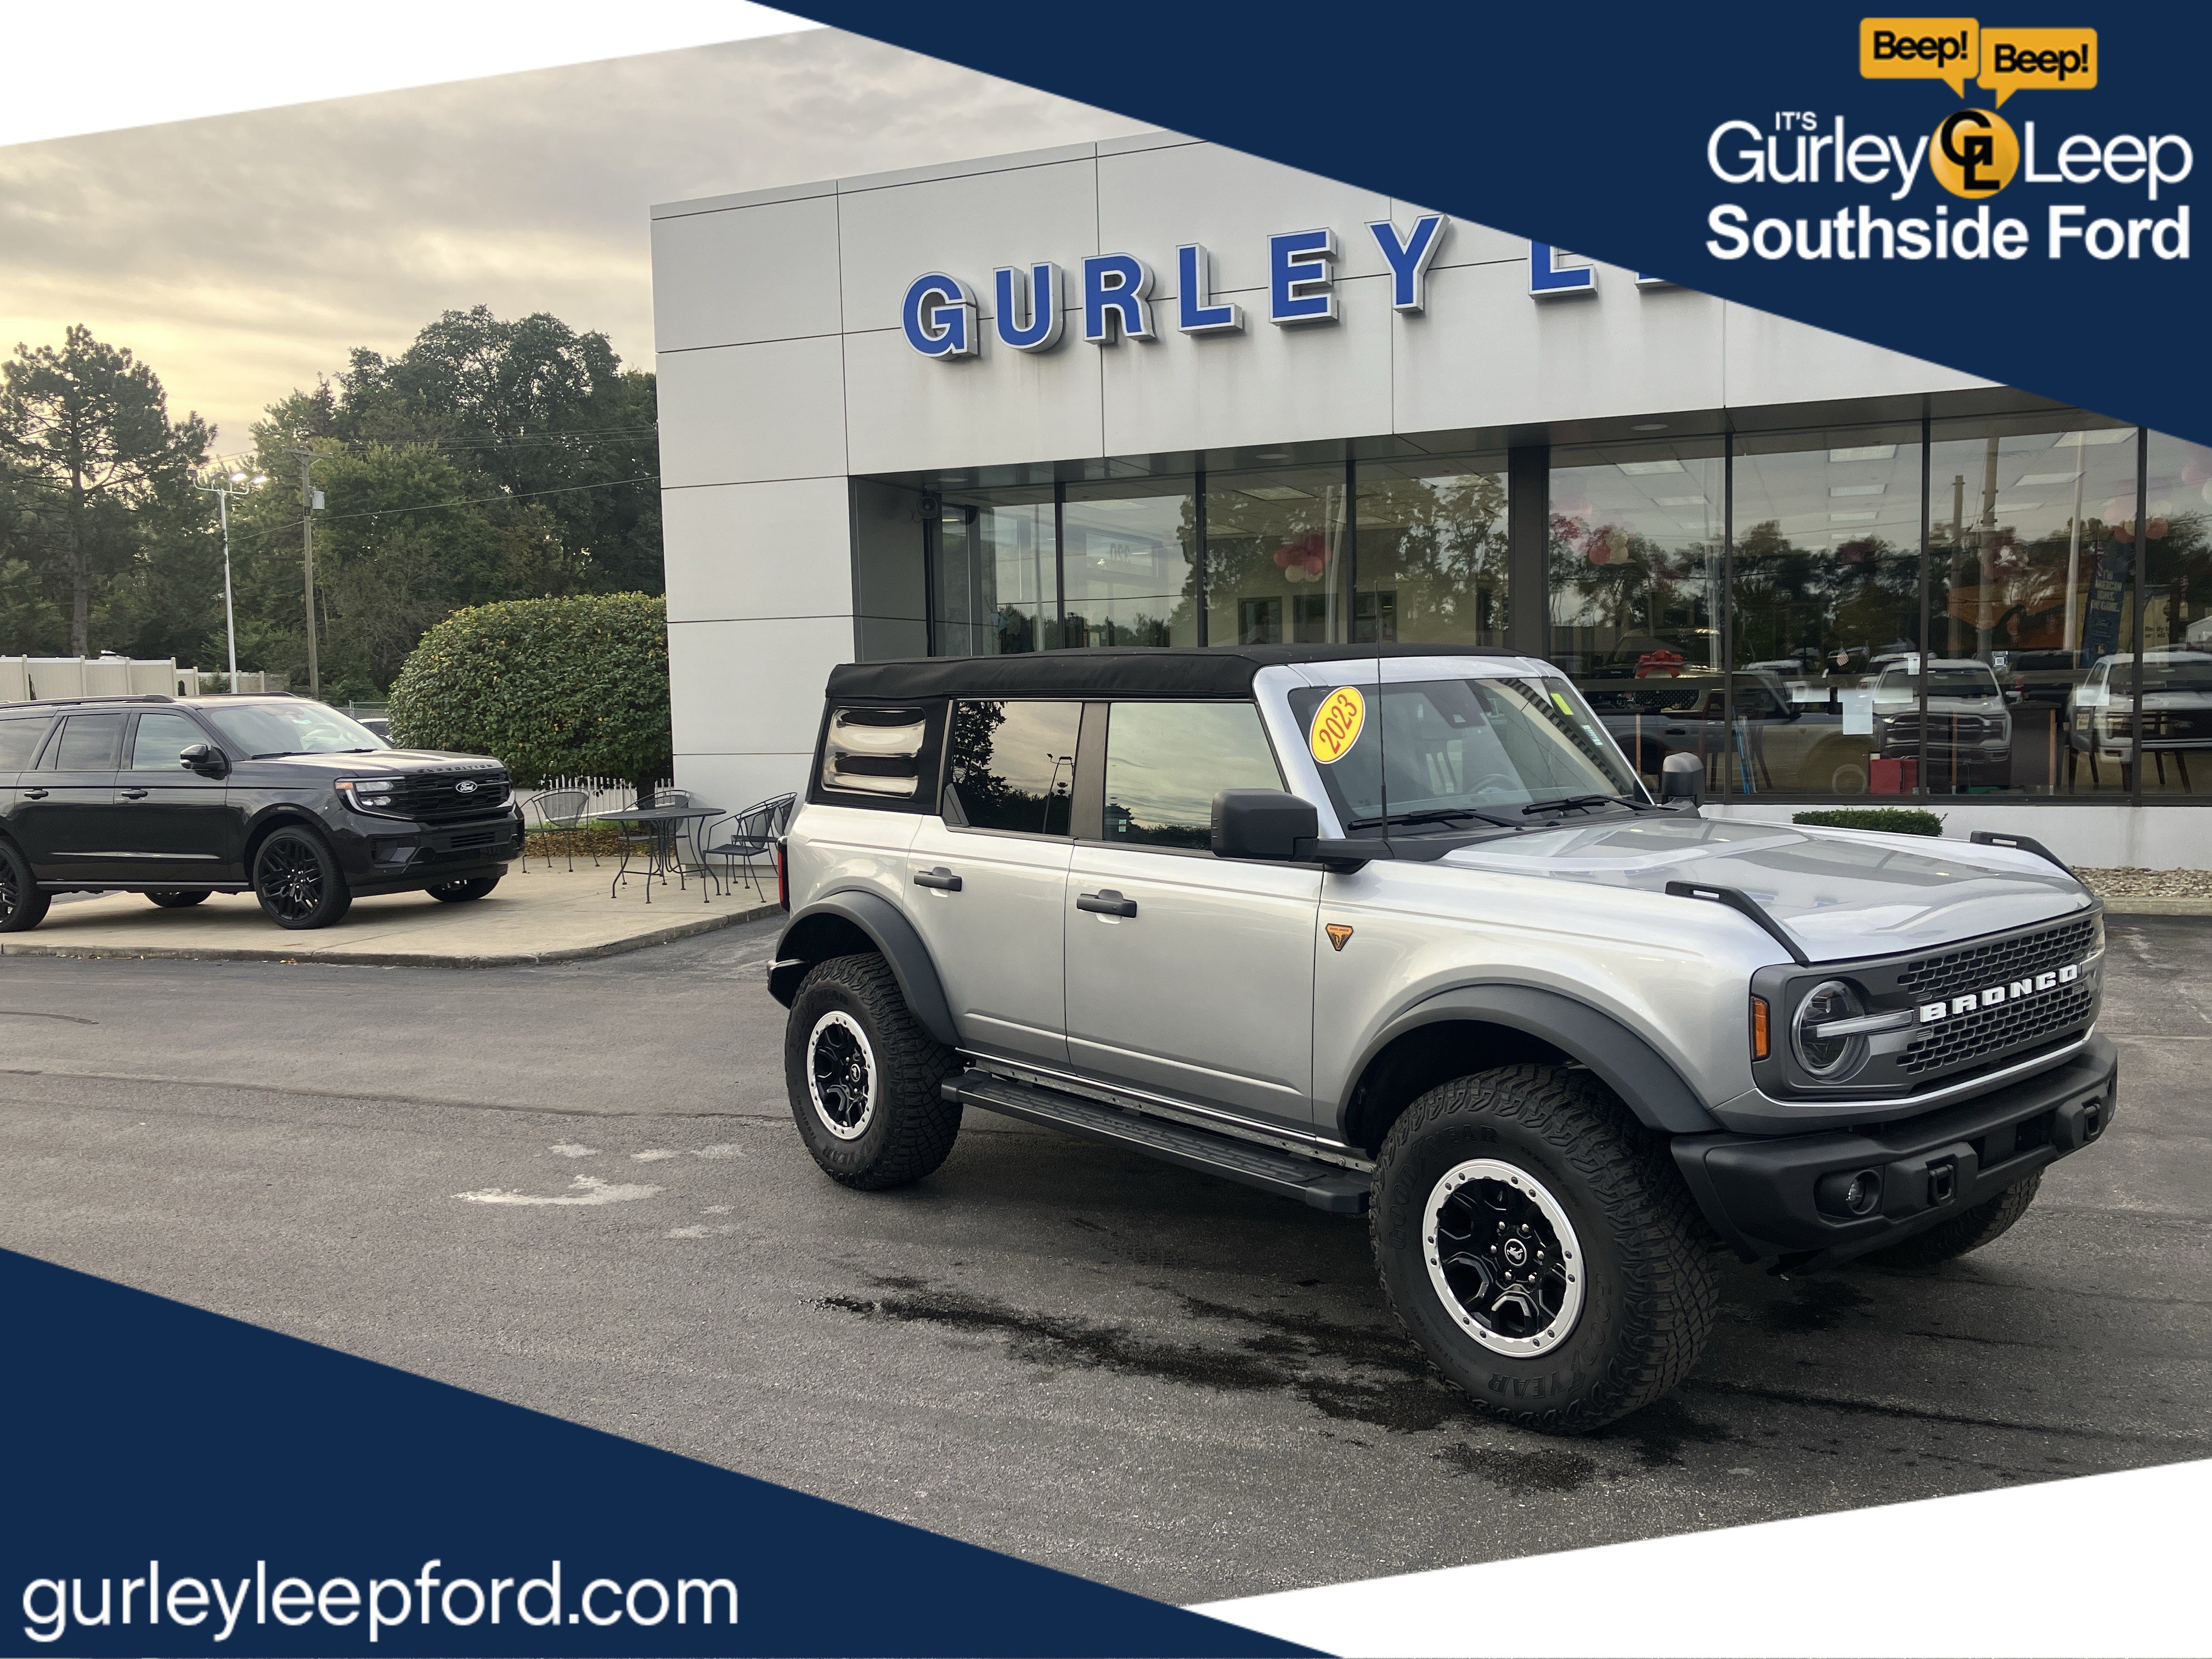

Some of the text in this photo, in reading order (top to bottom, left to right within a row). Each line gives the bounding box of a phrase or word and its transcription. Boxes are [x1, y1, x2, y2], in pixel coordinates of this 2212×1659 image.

[901, 214, 1450, 360] GURLEY
[1319, 693, 1357, 754] 2023
[1920, 964, 2078, 1023] BRONCO
